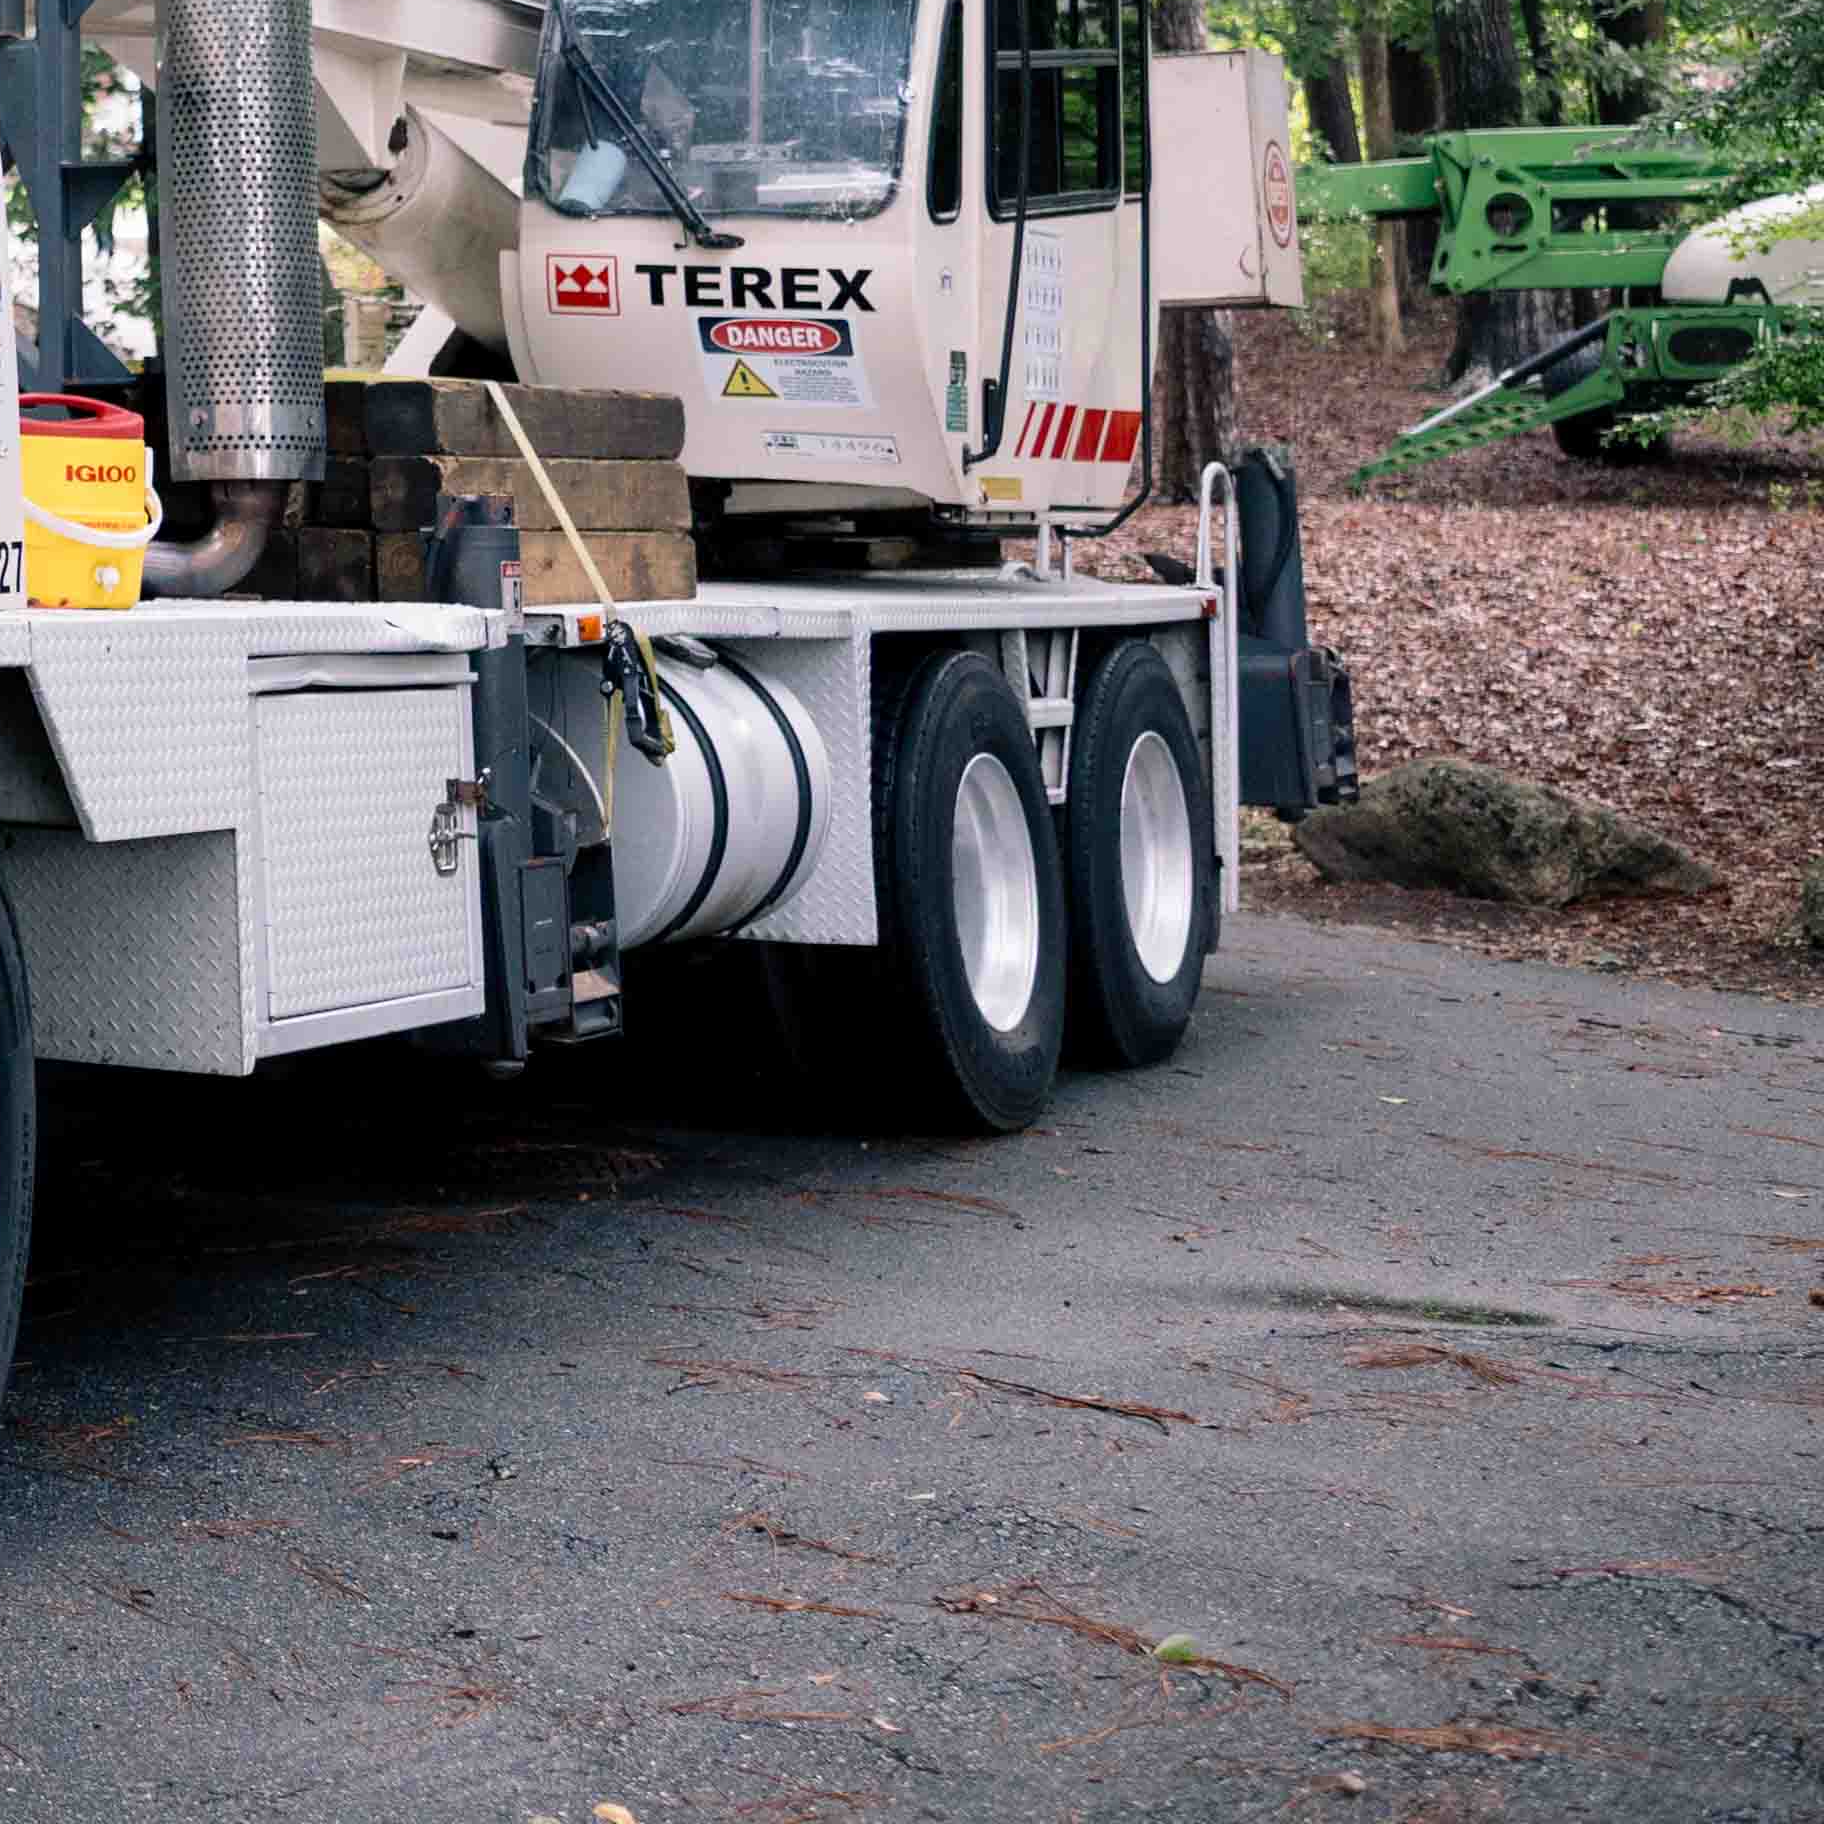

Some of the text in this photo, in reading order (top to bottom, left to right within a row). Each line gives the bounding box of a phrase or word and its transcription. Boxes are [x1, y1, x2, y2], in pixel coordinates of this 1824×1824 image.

[636, 263, 876, 312] TEREX
[726, 325, 822, 348] DANGER
[65, 465, 137, 484] IGLOO
